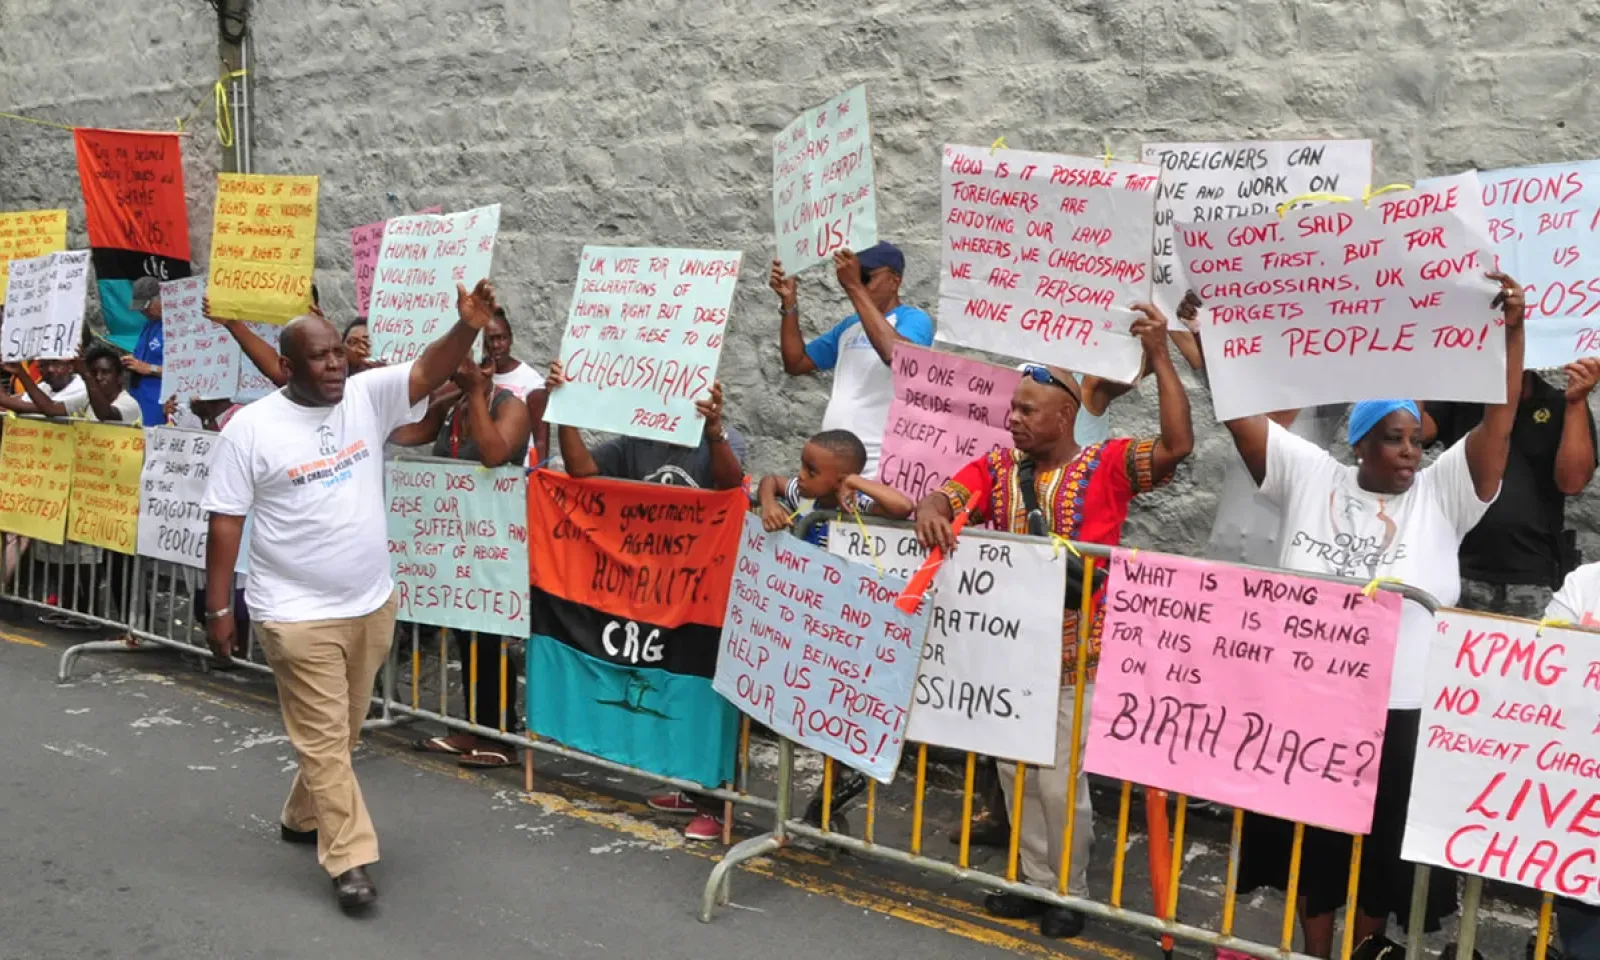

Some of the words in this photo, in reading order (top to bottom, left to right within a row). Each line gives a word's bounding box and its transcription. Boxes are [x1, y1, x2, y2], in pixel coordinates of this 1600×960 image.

[946, 148, 982, 175] "HOW
[995, 163, 1009, 178] IS
[1020, 165, 1037, 181] IT
[1050, 165, 1117, 188] POSSIBLE
[1125, 174, 1157, 191] THAT
[1287, 145, 1325, 167] CAN
[951, 181, 1038, 213] FOREIGNERS
[1060, 198, 1088, 215] ARE
[1197, 183, 1225, 199] AND
[1238, 175, 1288, 198] WORK
[1309, 175, 1339, 192] ON
[389, 218, 454, 237] CHAMPIONS
[465, 215, 478, 230] OF
[817, 212, 853, 257] US!
[947, 208, 1014, 234] ENJOYING
[1026, 220, 1053, 243] OUR
[1071, 227, 1112, 246] LAND
[1174, 224, 1214, 249] "UK
[1228, 223, 1284, 247] GOVT.
[1298, 212, 1353, 237] SAID
[1379, 187, 1458, 224] PEOPLE
[1537, 210, 1579, 235] BUT
[385, 243, 429, 261] HUMAN
[434, 238, 467, 260] RIGHTS
[583, 254, 605, 275] "UK
[615, 258, 639, 274] VOTE
[650, 257, 669, 279] FOR
[1020, 247, 1039, 263] WE
[1049, 248, 1146, 284] CHAGOSSIANS
[1190, 257, 1243, 275] COME
[1261, 250, 1326, 269] FIRST.
[1343, 239, 1384, 265] BUT
[1404, 226, 1447, 252] FOR
[1553, 245, 1579, 268] US
[214, 268, 306, 296] CHAGOSSIANS
[381, 267, 437, 288] VIOLATING
[581, 279, 657, 297] DECLARATIONS
[673, 283, 691, 297] OF
[951, 263, 972, 280] WE
[988, 267, 1021, 289] ARE
[1034, 276, 1115, 311] PERSONA
[1200, 276, 1359, 299] CHAGOSSIANS,
[1376, 268, 1405, 288] UK
[1420, 250, 1480, 281] GOVT.
[372, 315, 414, 336] RIGHTS
[422, 318, 439, 333] OF
[574, 300, 611, 318] HUMAN
[621, 303, 652, 321] RIGHT
[657, 304, 682, 320] BUT
[694, 306, 725, 325] DOES
[964, 299, 1013, 323] NONE
[1209, 300, 1304, 325] FORGETS
[1327, 298, 1385, 316] THAT
[1409, 292, 1445, 309] WE
[570, 324, 591, 339] NOT
[599, 325, 627, 340] APPLY
[635, 326, 670, 343] THESE
[682, 331, 698, 345] TO
[707, 334, 722, 348] US
[1223, 336, 1263, 359] ARE
[1281, 323, 1419, 359] PEOPLE
[565, 348, 710, 405] CHAGOSSIANS
[927, 365, 955, 386] ONE
[968, 376, 994, 396] CAN
[630, 408, 681, 432] PEOPLE
[906, 388, 952, 413] DECIDE
[969, 403, 990, 426] FOR
[893, 417, 947, 454] EXCEPT,
[955, 435, 978, 457] WE
[446, 472, 475, 491] DOES
[493, 477, 519, 492] NOT
[390, 496, 422, 517] EASE
[434, 497, 460, 517] OUR
[158, 525, 208, 558] PEOPLE
[414, 518, 496, 542] SUFFERINGS
[508, 524, 526, 543] AND
[619, 533, 699, 556] AGAINST
[415, 541, 445, 555] RIGHT
[453, 545, 467, 558] OF
[473, 547, 508, 560] ABODE
[775, 544, 810, 574] WANT
[823, 566, 841, 585] TO
[979, 544, 1013, 568] FOR
[396, 562, 436, 579] SHOULD
[456, 566, 471, 579] BE
[958, 568, 994, 595] NO
[1114, 556, 1177, 588] "WHAT
[1200, 574, 1217, 590] IS
[1244, 577, 1318, 606] WRONG
[1342, 593, 1365, 610] IF
[738, 556, 760, 584] OUR
[766, 574, 824, 610] CULTURE
[841, 604, 872, 629] AND
[884, 621, 913, 649] FOR
[1114, 590, 1213, 624] SOMEONE
[1241, 612, 1262, 631] IS
[1284, 616, 1371, 646] ASKING
[734, 579, 770, 612] PEOPLE
[778, 605, 795, 623] TO
[803, 614, 864, 650] RESPECT
[876, 645, 896, 664] US
[602, 620, 665, 663] CRG
[731, 605, 742, 625] AS
[750, 617, 792, 650] HUMAN
[803, 644, 872, 684] BEINGS!
[1111, 622, 1142, 648] FOR
[1158, 631, 1191, 653] HIS
[1213, 636, 1274, 662] RIGHT
[1293, 652, 1313, 671] TO
[1327, 659, 1370, 679] LIVE
[1437, 621, 1567, 687] "KPMG
[727, 631, 770, 672] HELP
[784, 661, 811, 690] US
[829, 678, 907, 732] PROTECT
[1122, 657, 1146, 675] ON
[1166, 664, 1201, 684] HIS
[736, 673, 776, 724] OUR
[1434, 685, 1481, 716] NO
[1493, 701, 1566, 730] LEGAL
[1104, 692, 1226, 764] BIRTH
[1428, 725, 1529, 763] PREVENT
[1445, 824, 1600, 896] CHAG
